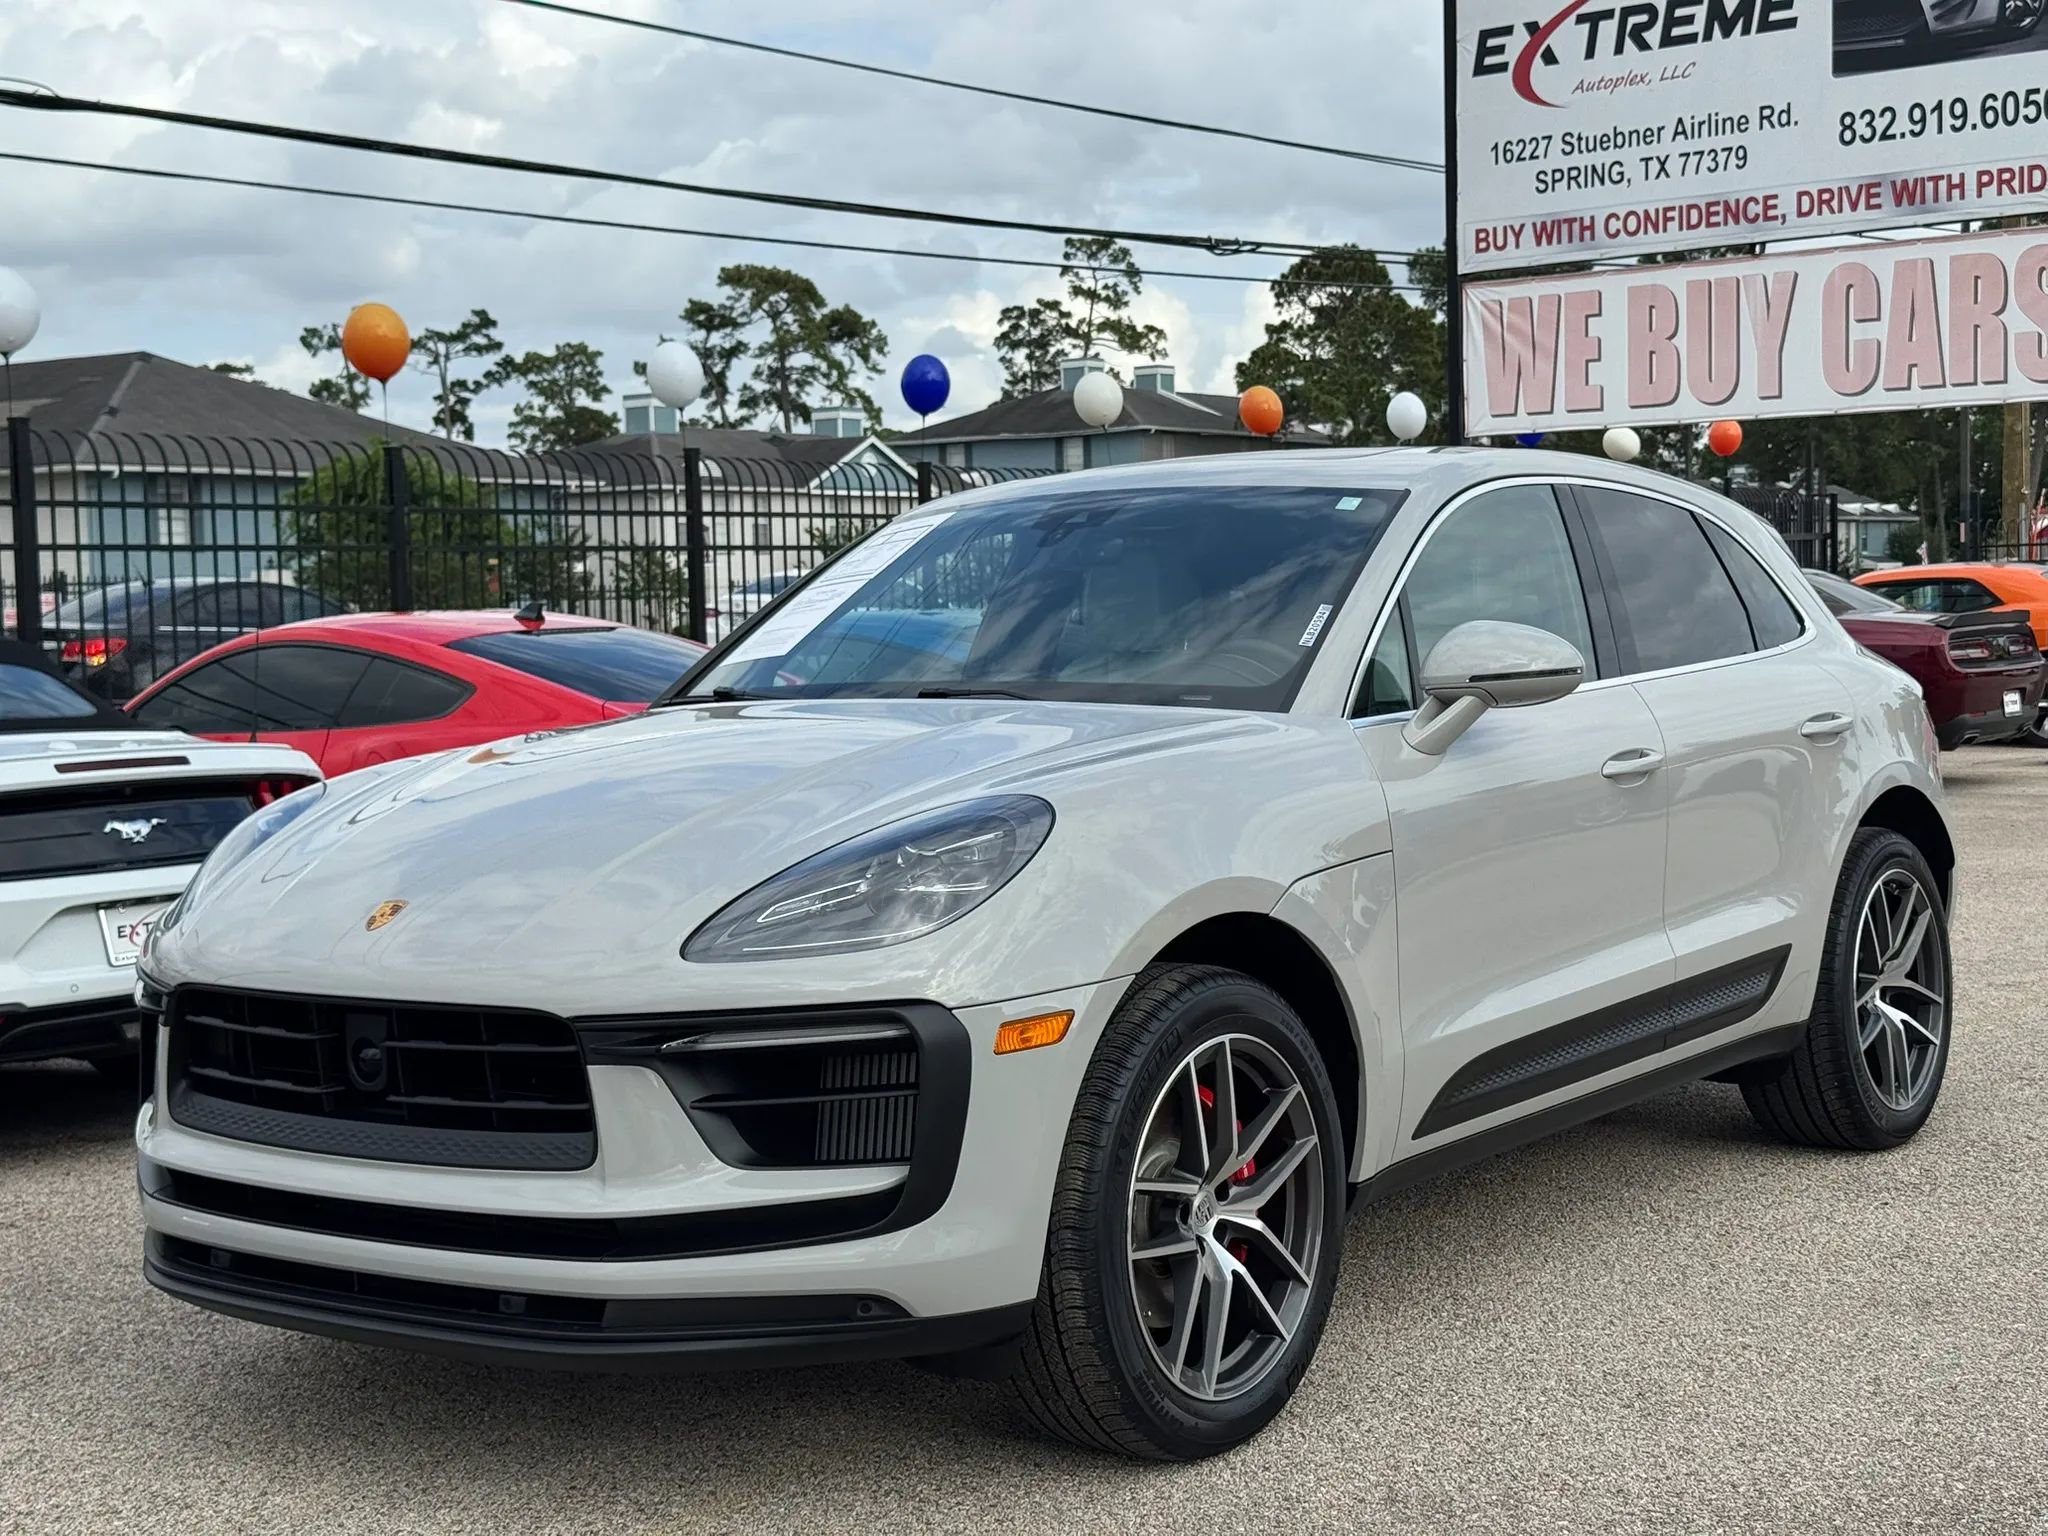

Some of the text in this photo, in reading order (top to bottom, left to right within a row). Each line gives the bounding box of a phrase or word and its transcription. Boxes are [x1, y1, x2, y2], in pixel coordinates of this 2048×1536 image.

[1571, 61, 1697, 95] Autoplex, LLC
[1490, 102, 1800, 166] 16227 Stuebner Airline Rd.
[1838, 87, 2048, 147] 832.919.605
[1534, 145, 1748, 195] SPRING, TX 77379
[1474, 163, 2048, 254] BUY WITH CONFIDENCE, DRIVE WITH PRID
[1480, 289, 1604, 417] WE
[1627, 270, 1799, 409] BUY
